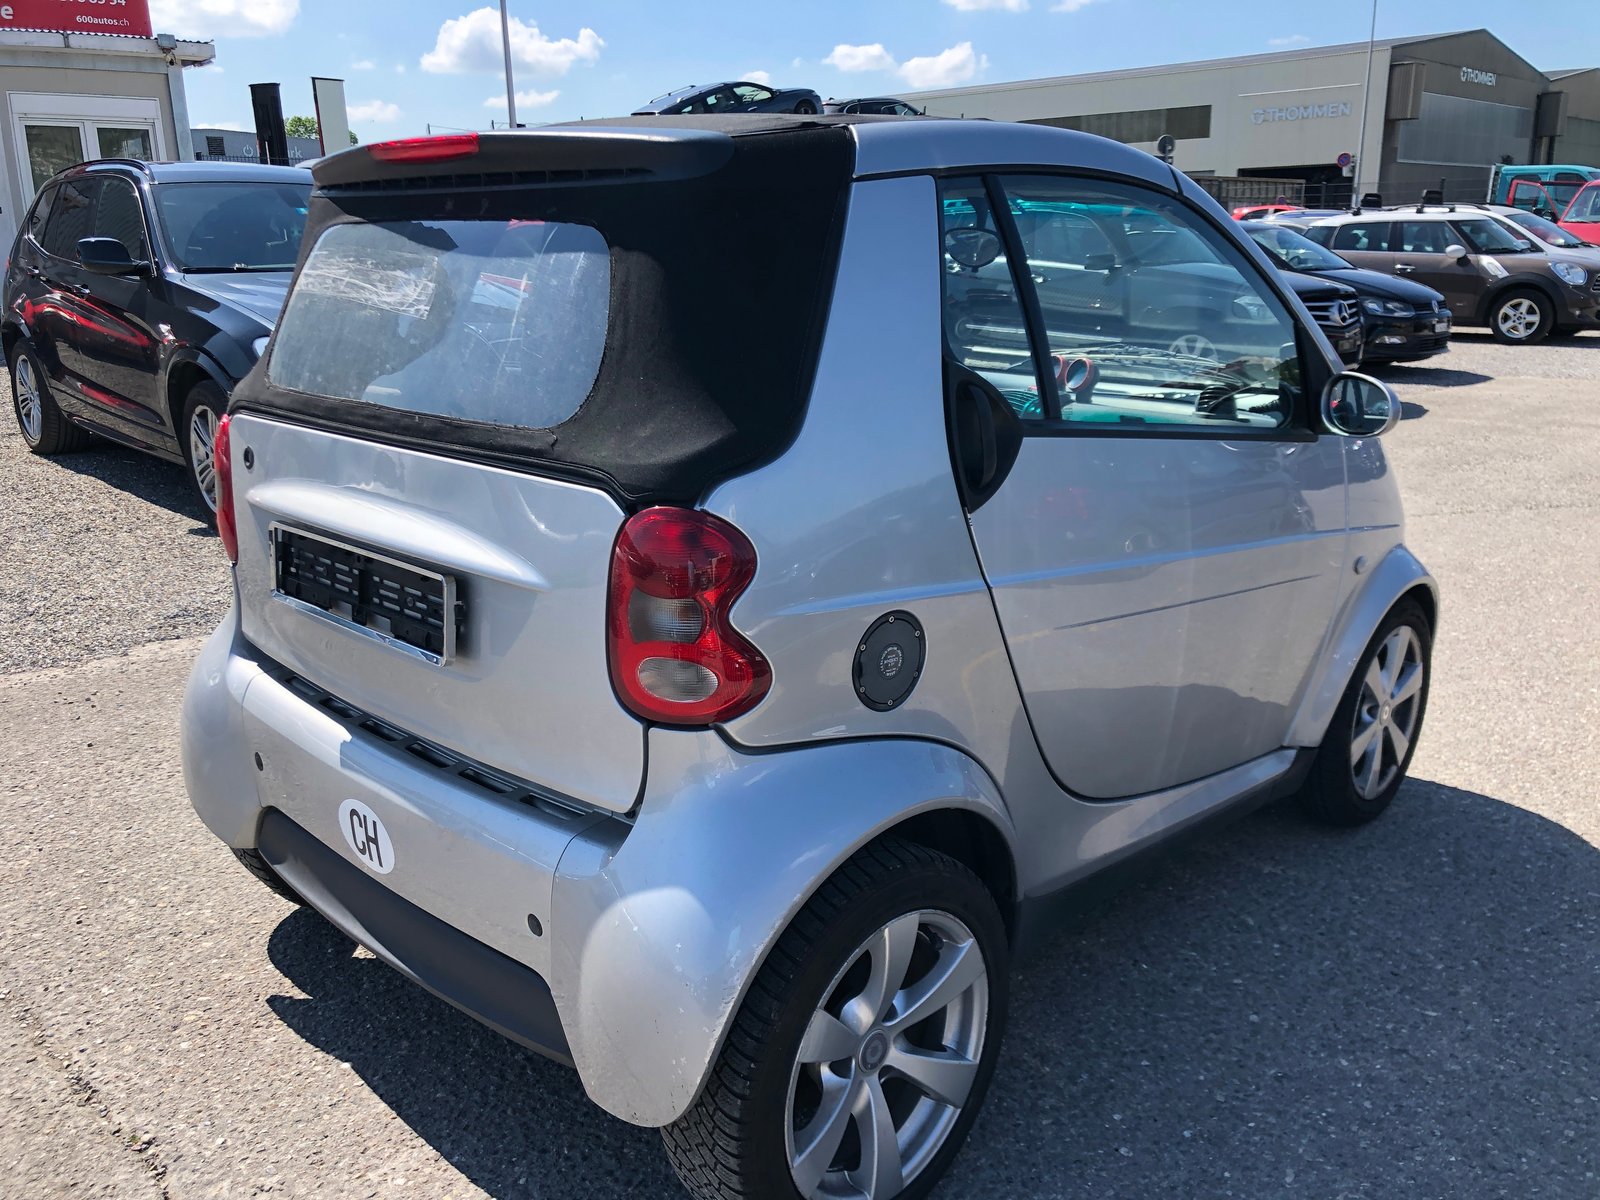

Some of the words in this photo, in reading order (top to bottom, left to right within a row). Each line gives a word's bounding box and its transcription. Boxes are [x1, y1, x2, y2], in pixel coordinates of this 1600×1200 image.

[76, 15, 130, 27] 600autos.ch
[1267, 102, 1352, 122] THOMMEN
[349, 808, 384, 868] CH
